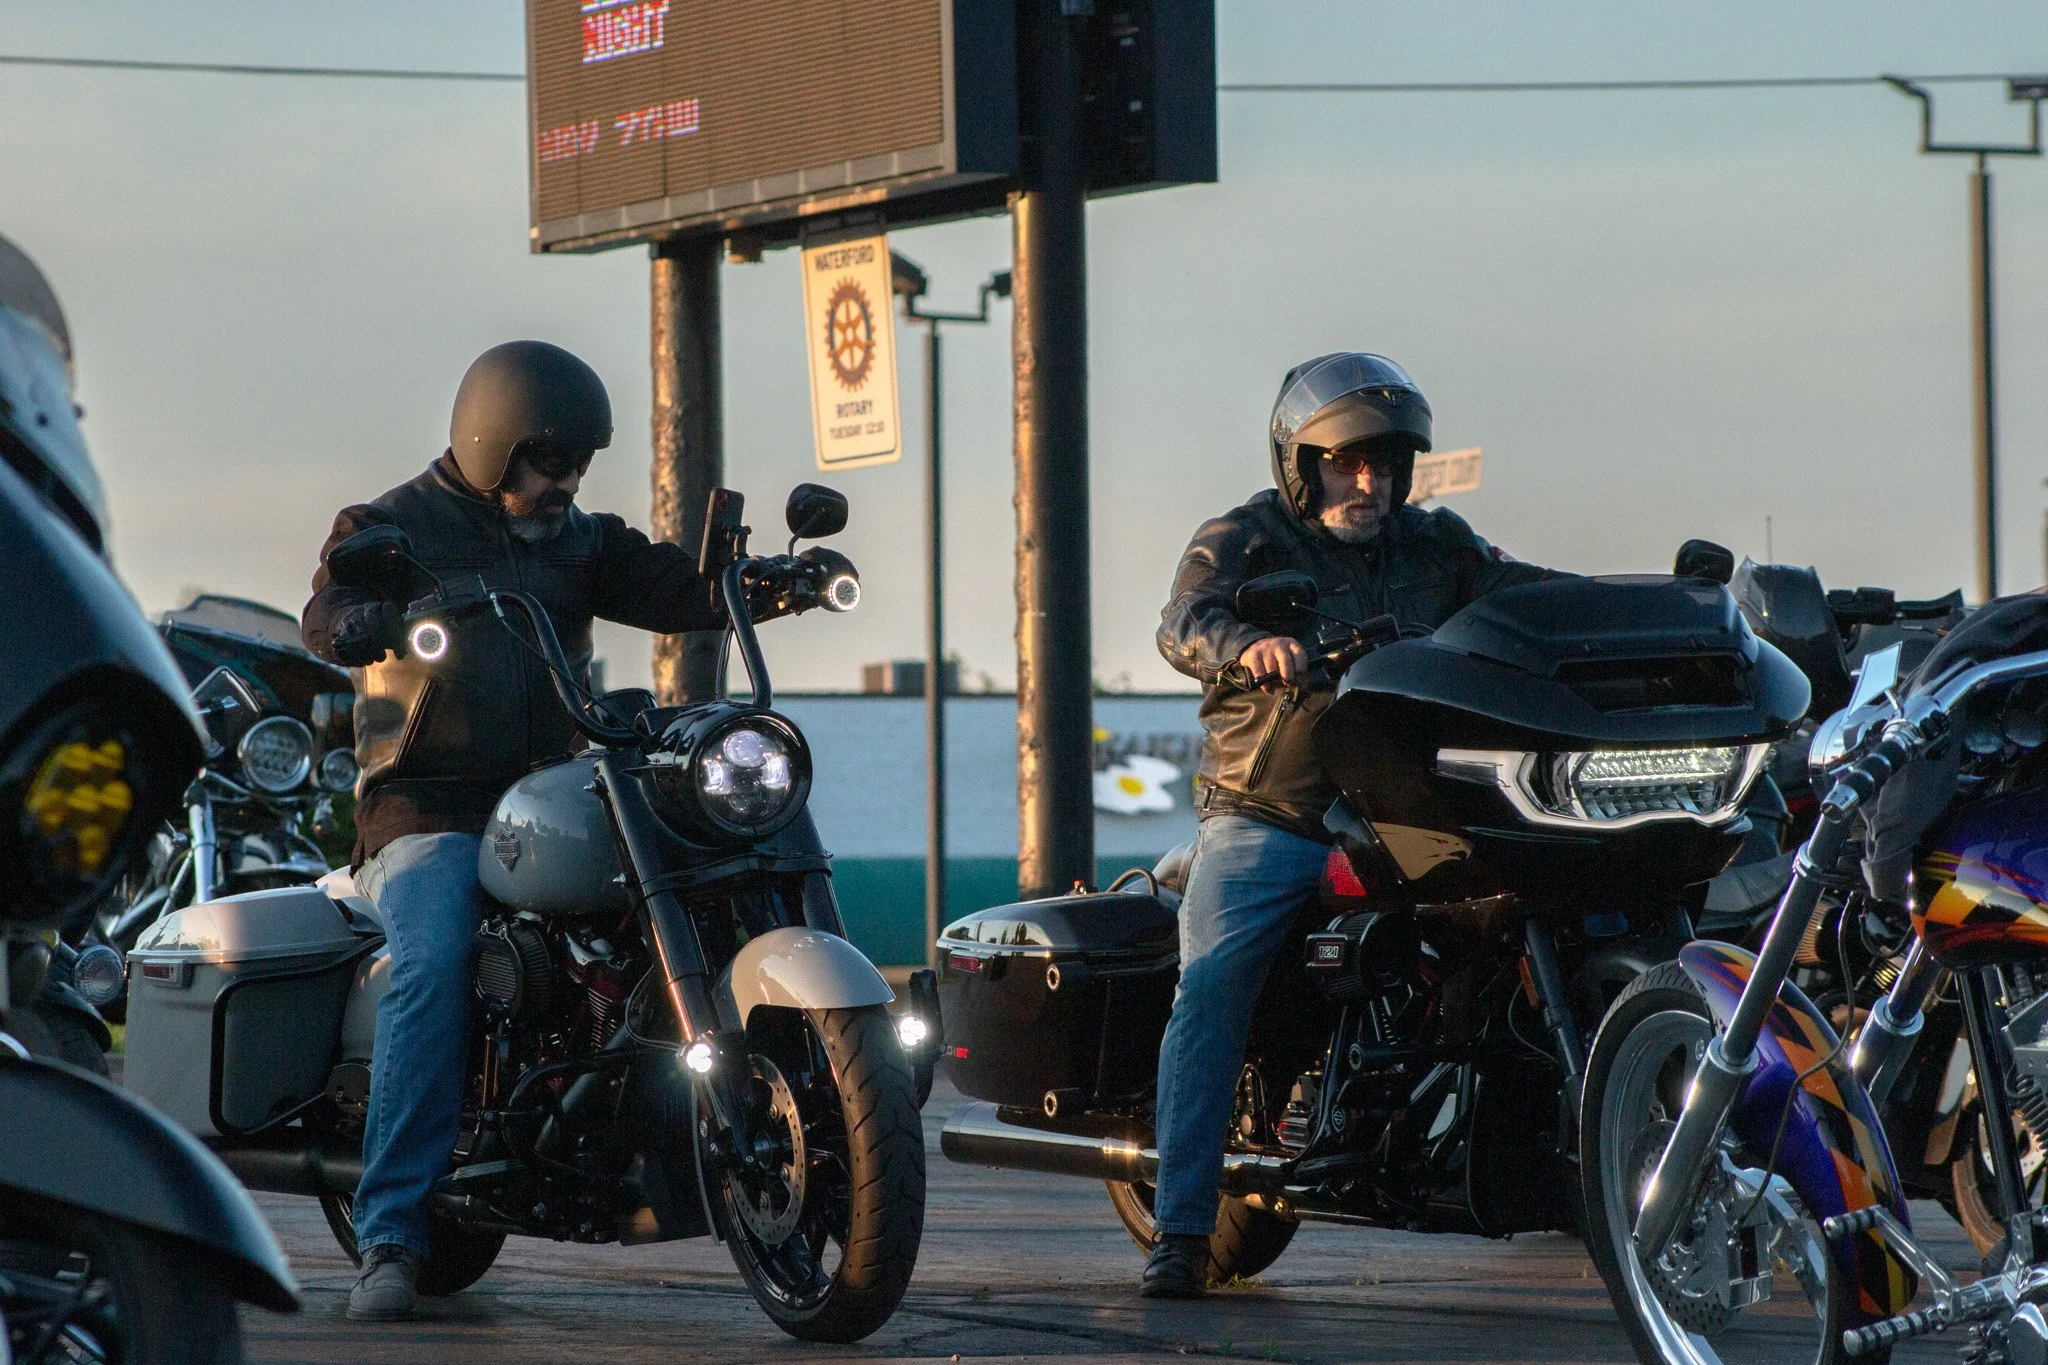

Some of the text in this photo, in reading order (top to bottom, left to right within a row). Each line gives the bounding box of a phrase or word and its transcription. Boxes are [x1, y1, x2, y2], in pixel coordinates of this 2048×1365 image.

[582, 0, 669, 64] NIGHT
[814, 244, 875, 272] WATERFORD
[836, 399, 873, 418] ROTARY
[1318, 945, 1340, 958] 121
